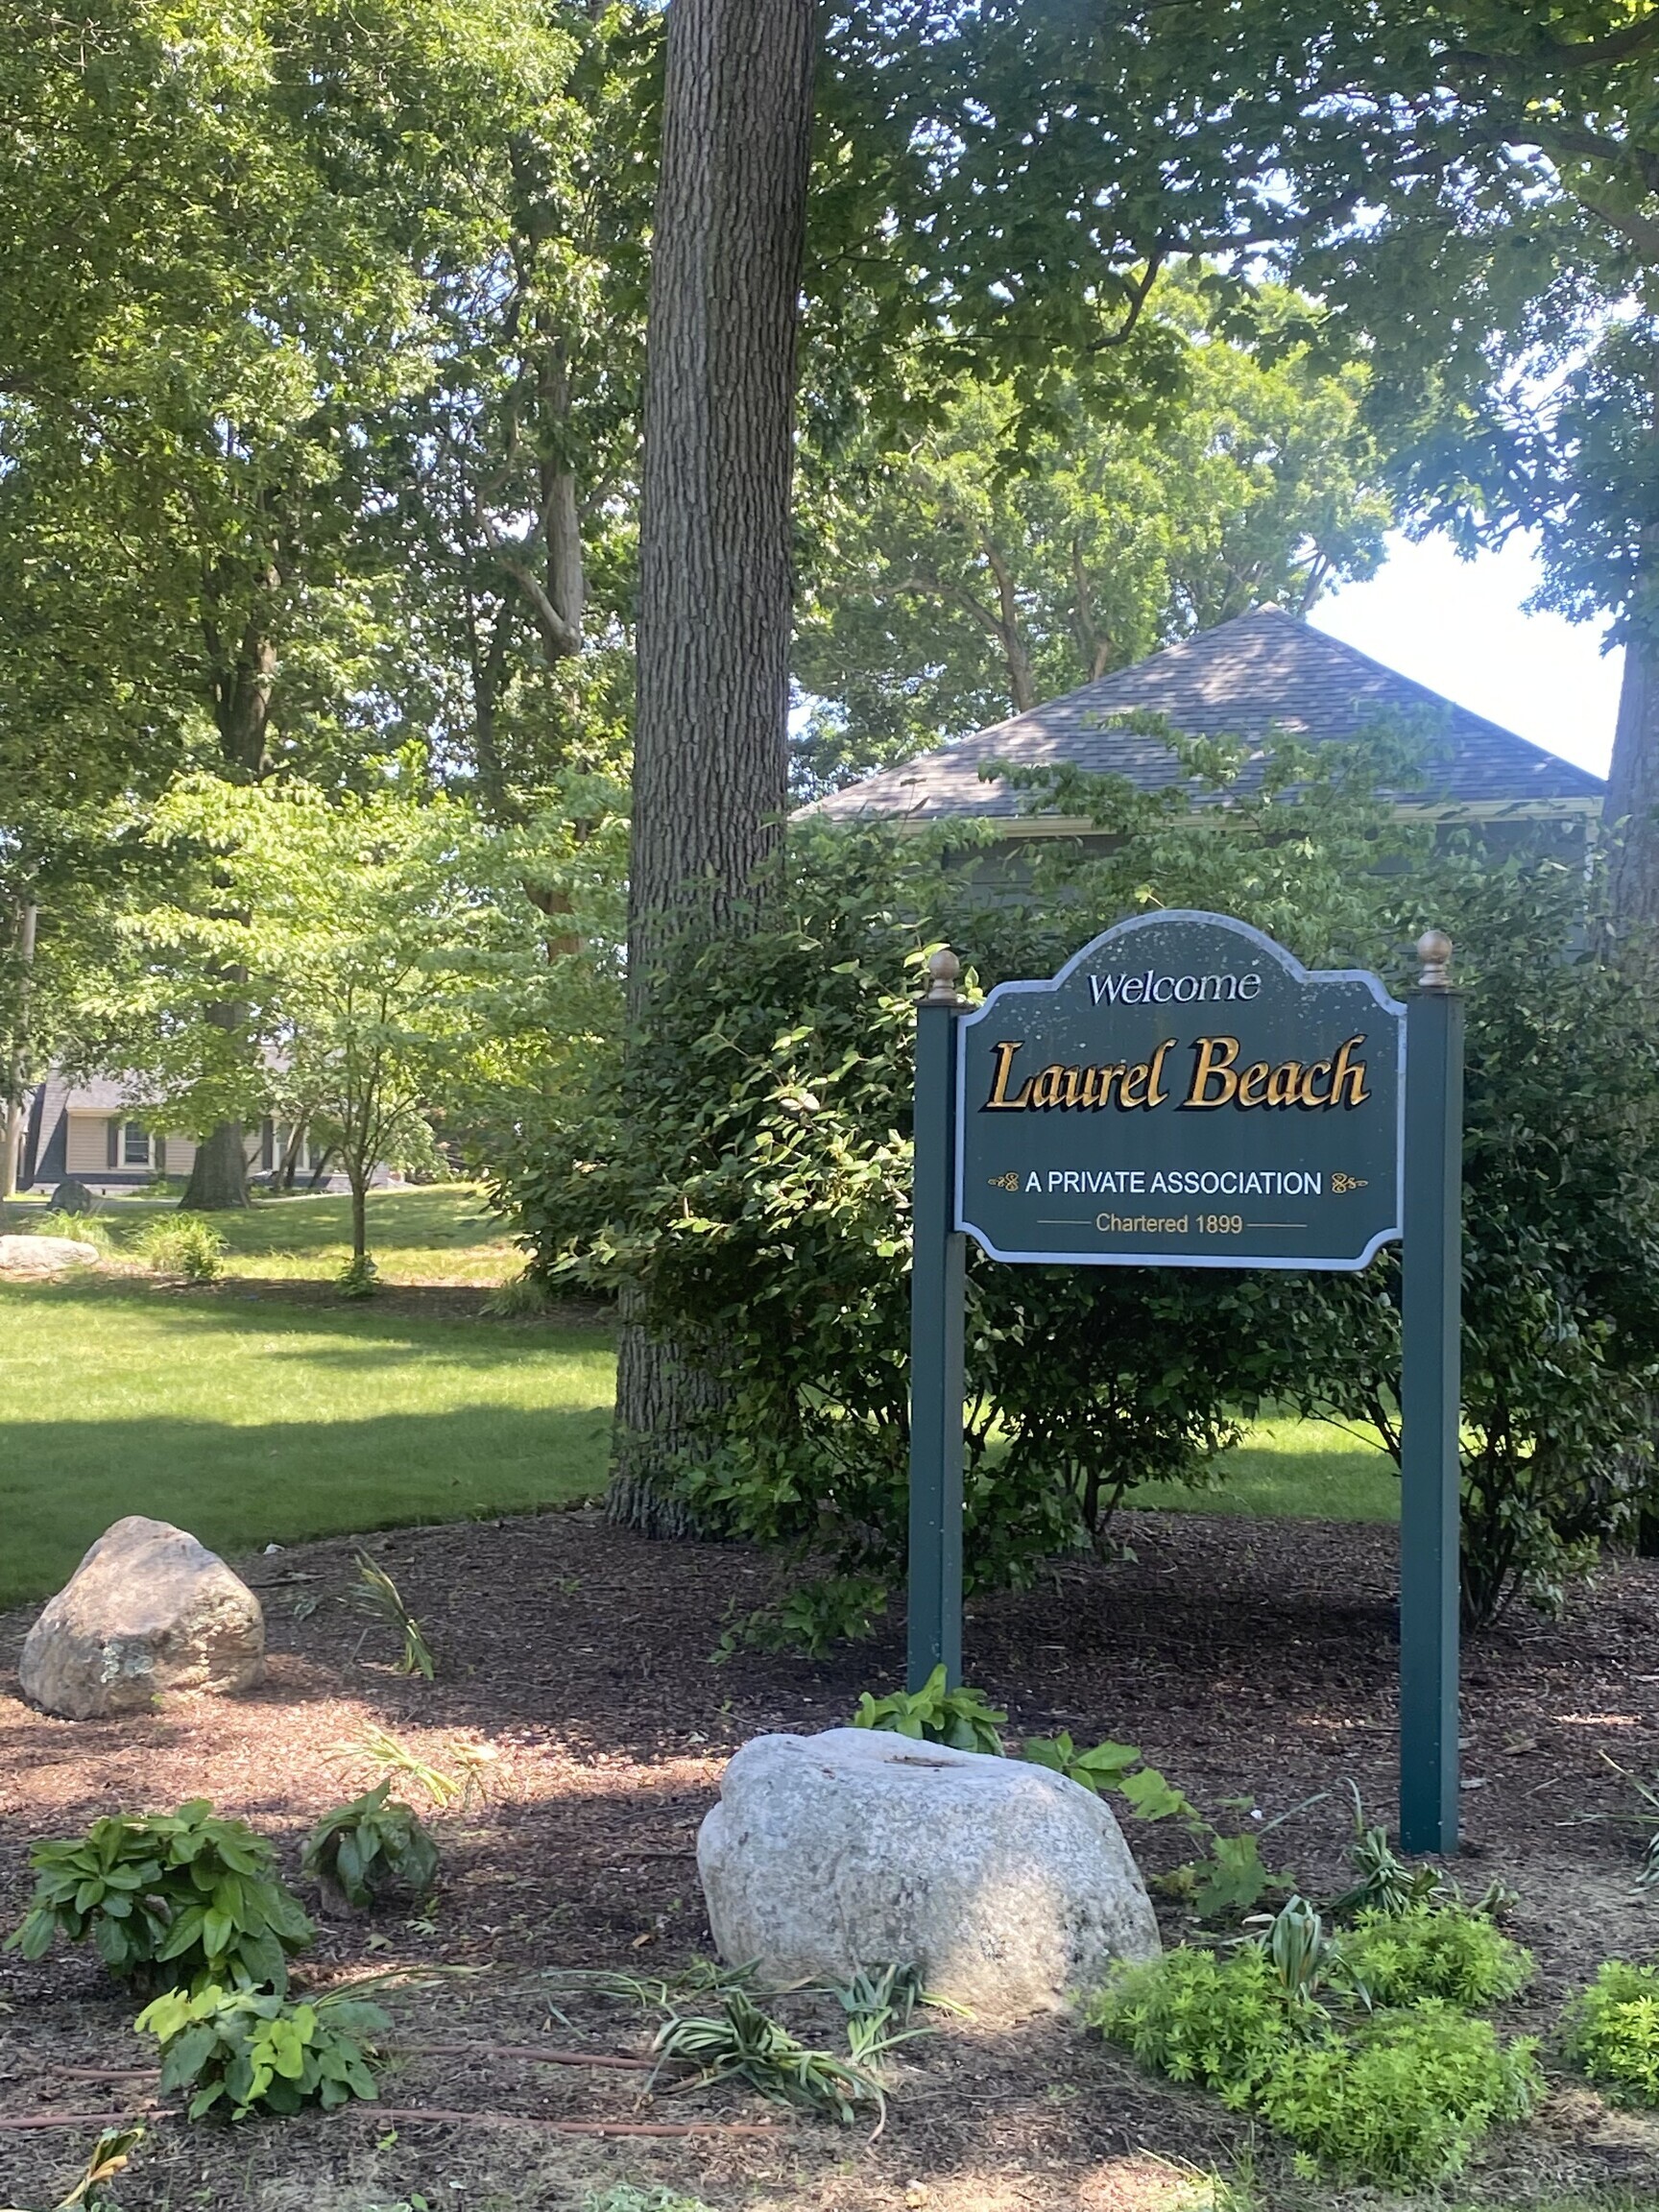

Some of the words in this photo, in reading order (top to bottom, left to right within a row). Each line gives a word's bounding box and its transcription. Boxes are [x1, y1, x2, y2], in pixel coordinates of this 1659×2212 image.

[1089, 970, 1262, 1005] Welcome
[984, 1037, 1178, 1111] Laurel
[1181, 1034, 1371, 1111] Beach
[1024, 1170, 1043, 1193] A
[1047, 1170, 1145, 1194] PRIVATE
[1150, 1171, 1322, 1195] ASSOCIATION
[1095, 1213, 1189, 1234] Chartered
[1195, 1214, 1243, 1235] 1899
